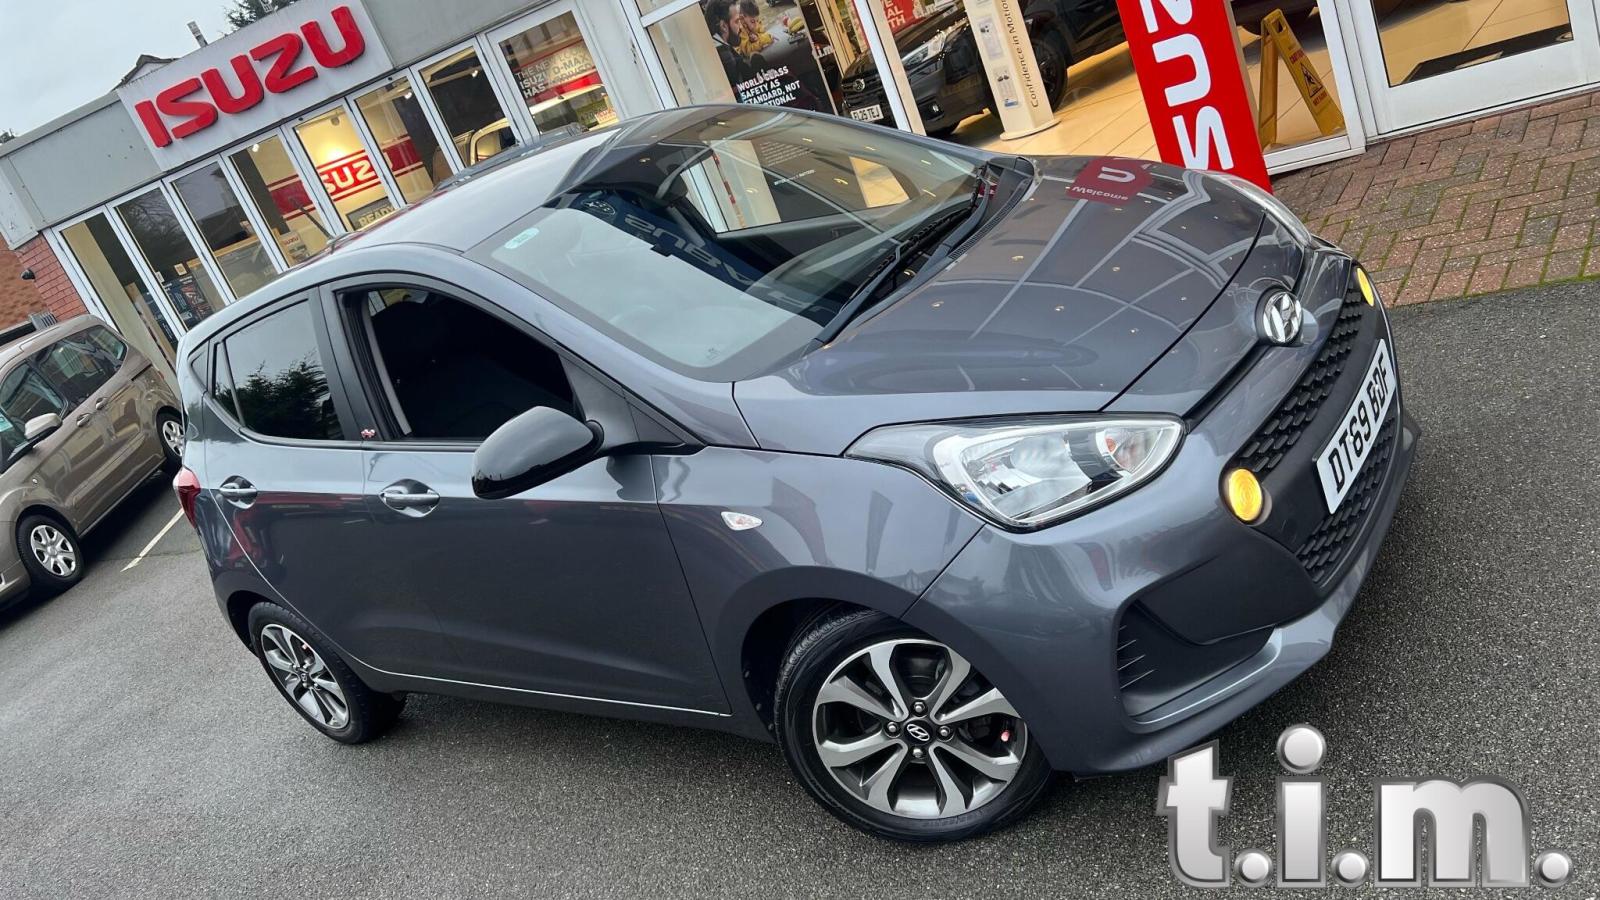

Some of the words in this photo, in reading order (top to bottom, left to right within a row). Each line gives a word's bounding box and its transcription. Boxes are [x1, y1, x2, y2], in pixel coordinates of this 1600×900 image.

[1012, 35, 1021, 45] in
[515, 67, 534, 80] THE
[552, 55, 590, 75] D-MAX
[135, 5, 366, 148] ISUZU
[736, 75, 764, 92] WORLD
[1016, 47, 1039, 108] Confidence
[523, 84, 546, 98] HAS
[740, 83, 769, 100] SAFETY
[770, 79, 781, 89] AS
[785, 80, 801, 93] NOT
[764, 93, 796, 106] TIONAL
[321, 152, 393, 193] SUZ
[1328, 400, 1371, 494] DT69
[1366, 352, 1389, 424] BDF
